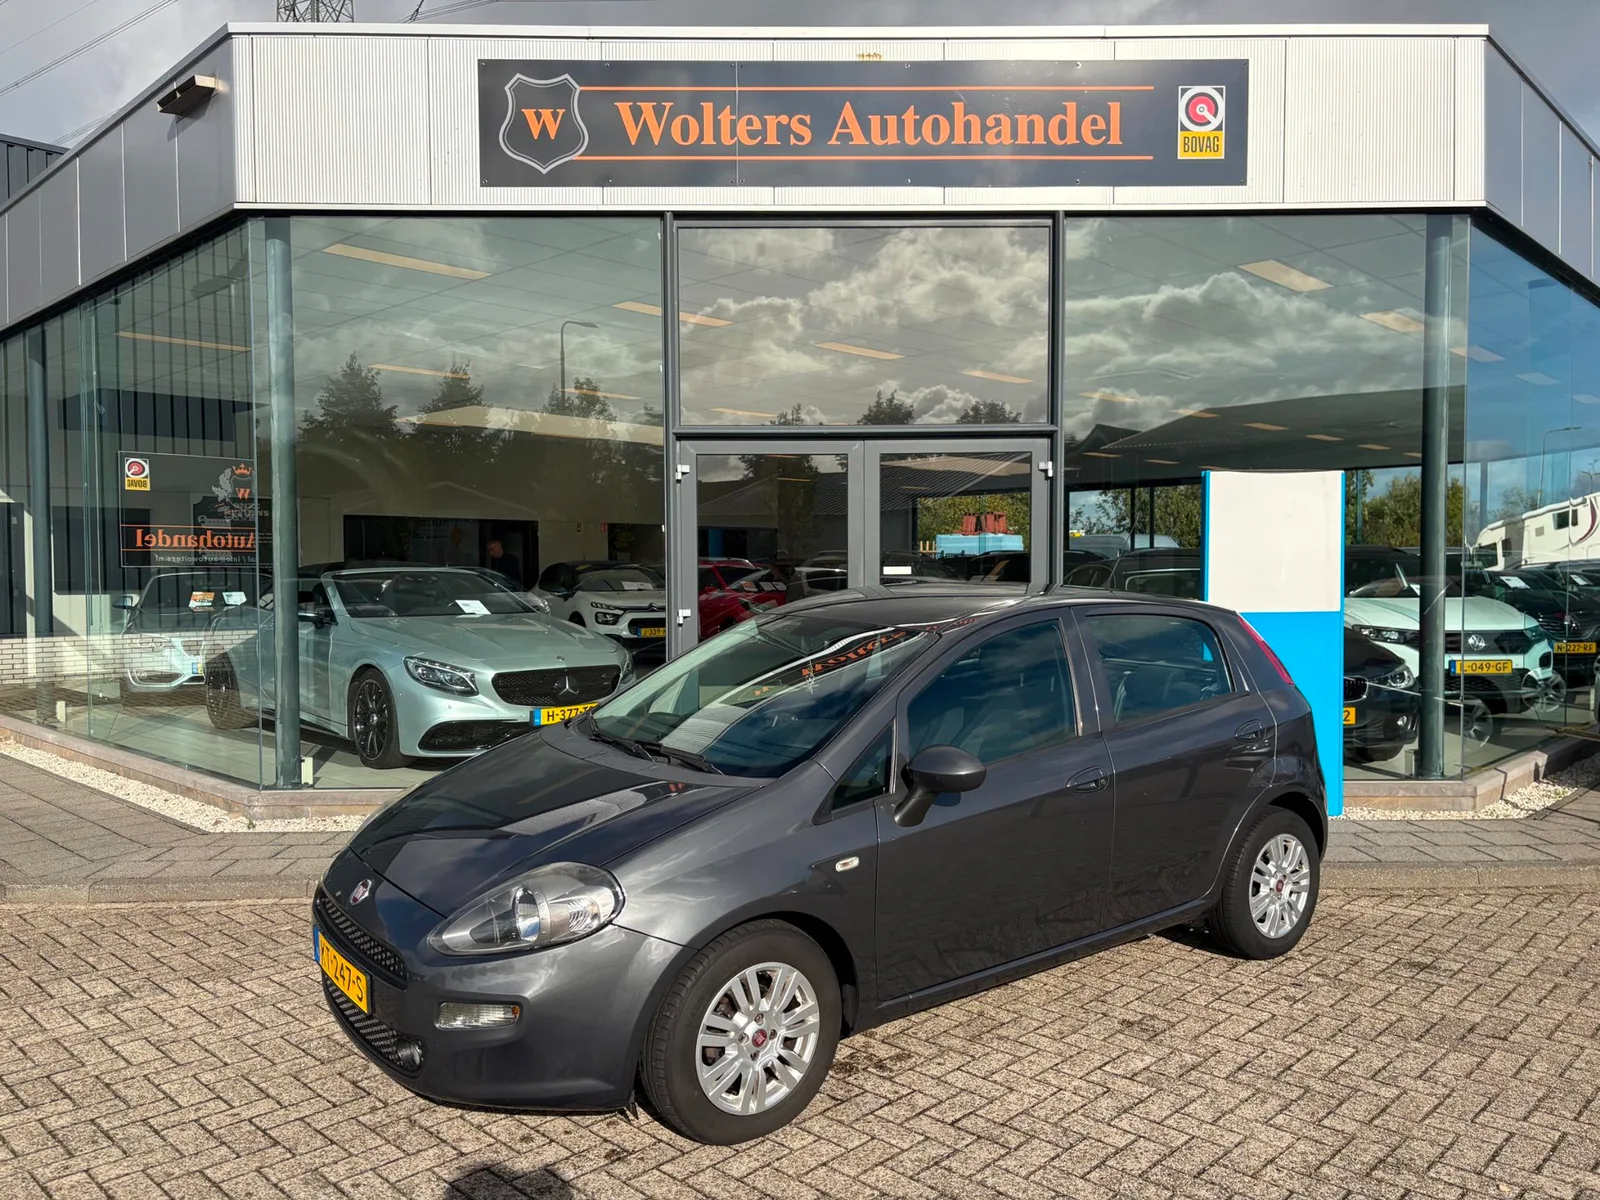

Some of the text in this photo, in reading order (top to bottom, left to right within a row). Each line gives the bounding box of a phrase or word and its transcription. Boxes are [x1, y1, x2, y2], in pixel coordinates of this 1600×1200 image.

[521, 108, 566, 140] W
[614, 101, 1123, 146] Wolters Autohandel
[1183, 135, 1220, 154] BOVAG
